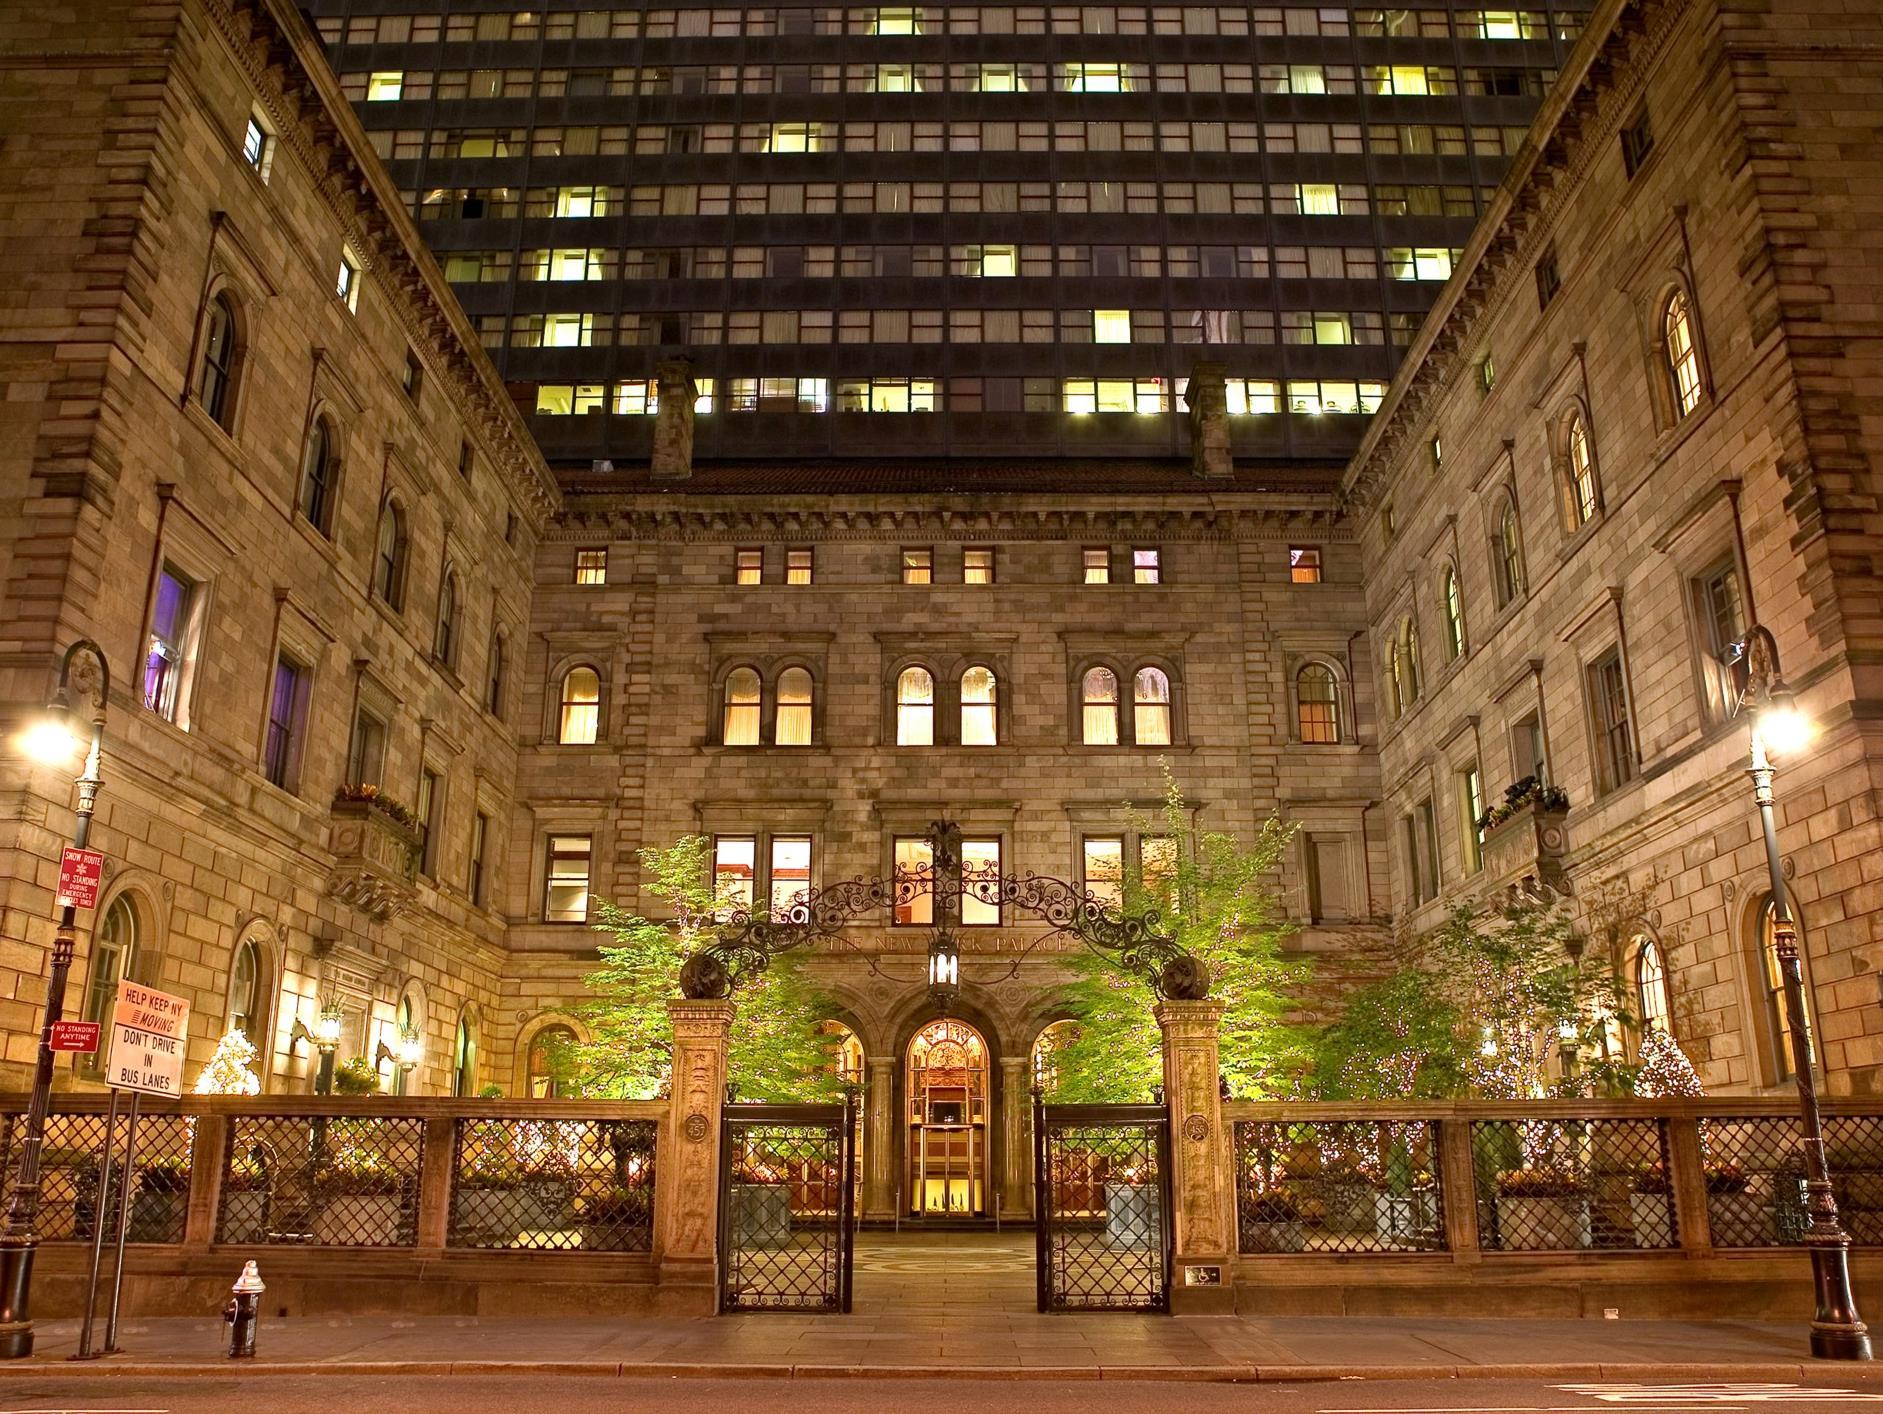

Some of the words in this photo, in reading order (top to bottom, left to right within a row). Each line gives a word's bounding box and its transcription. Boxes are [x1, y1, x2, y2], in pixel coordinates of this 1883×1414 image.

[65, 851, 81, 861] SNOW
[84, 854, 101, 865] ROUTE
[62, 872, 70, 881] NO
[72, 874, 98, 887] STANDING
[62, 889, 93, 900] EMERGENCY
[826, 935, 863, 951] THE
[875, 935, 915, 952] NEW
[995, 936, 1069, 952] PALACE
[125, 988, 148, 1006] HELP
[148, 995, 170, 1014] KEEP
[171, 1002, 183, 1017] NY
[67, 1025, 96, 1034] STANDING
[140, 1012, 175, 1033] MOVING
[60, 1033, 91, 1041] ANYTIME
[123, 1029, 149, 1047] DON'T
[152, 1036, 176, 1055] DRIVE
[143, 1053, 153, 1068] IN
[121, 1068, 139, 1084] BUS
[142, 1072, 170, 1090] LANES
[688, 1125, 705, 1137] 457
